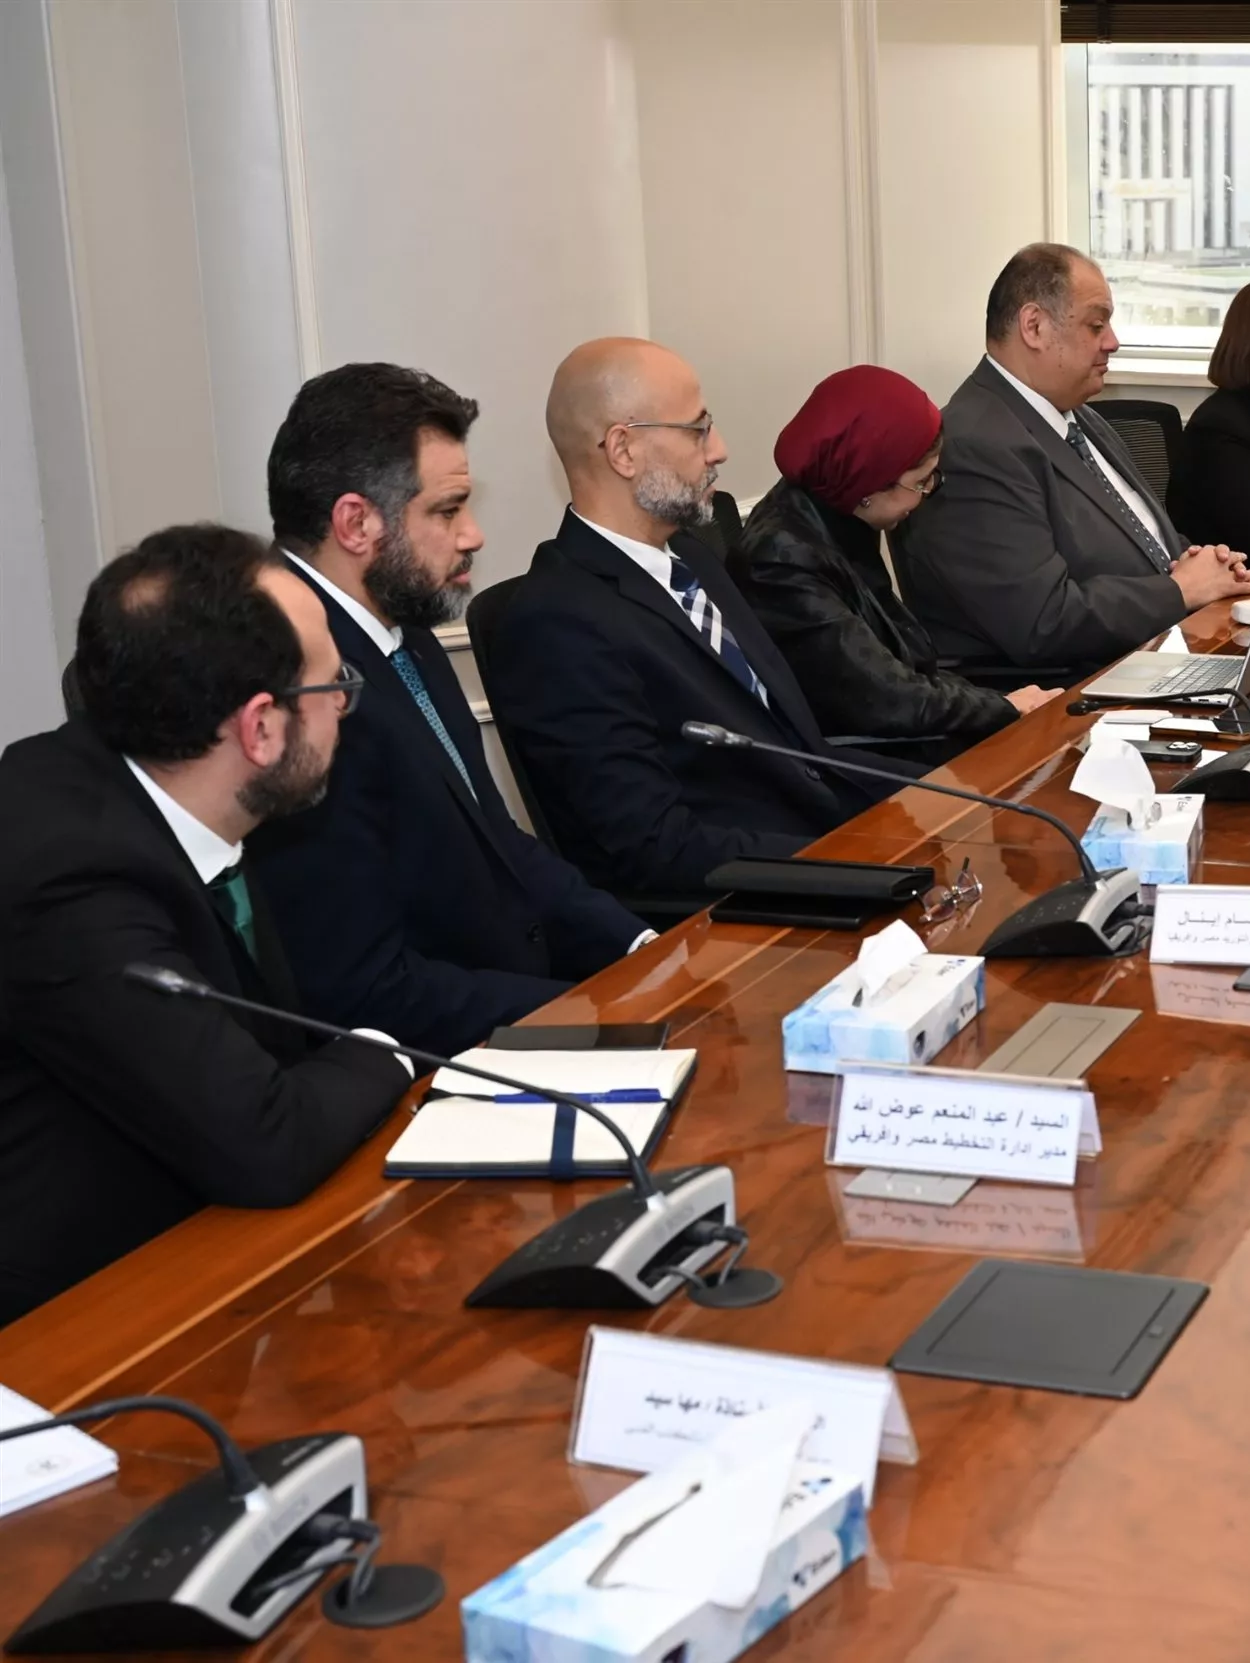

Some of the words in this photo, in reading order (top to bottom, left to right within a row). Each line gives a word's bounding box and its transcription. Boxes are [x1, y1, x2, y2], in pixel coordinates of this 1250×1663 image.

[853, 1093, 874, 1112] الله
[879, 1096, 925, 1119] عوض
[932, 1103, 977, 1122] المنعم
[983, 1107, 1008, 1127] عبد
[1030, 1113, 1070, 1131] السيد
[906, 1134, 938, 1148] مصر
[942, 1130, 996, 1152] التخطيط
[1037, 1145, 1068, 1160] مدير
